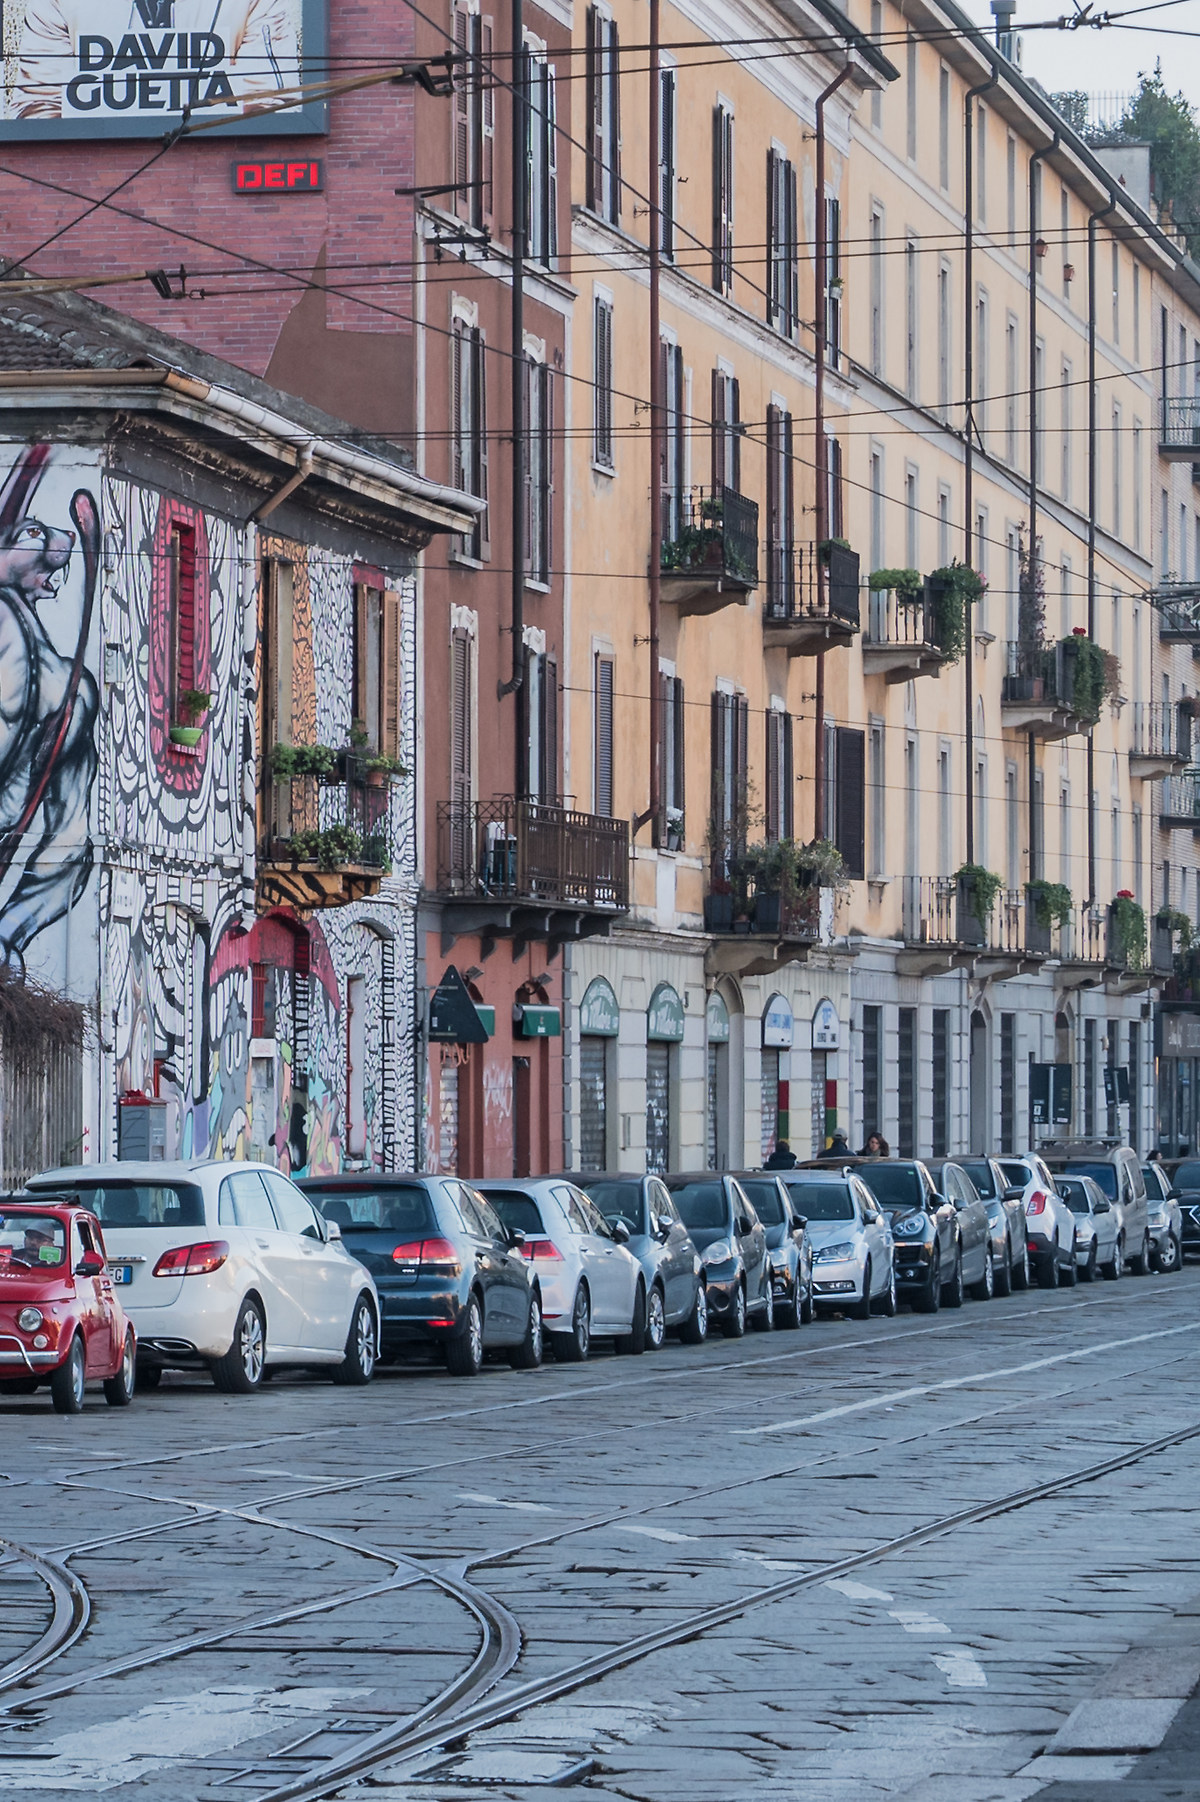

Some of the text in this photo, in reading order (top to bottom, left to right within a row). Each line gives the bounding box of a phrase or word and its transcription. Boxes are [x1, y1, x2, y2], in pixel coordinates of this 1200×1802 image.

[79, 32, 226, 71] DAVID
[66, 70, 238, 112] GUETTA
[236, 162, 319, 188] DEFI
